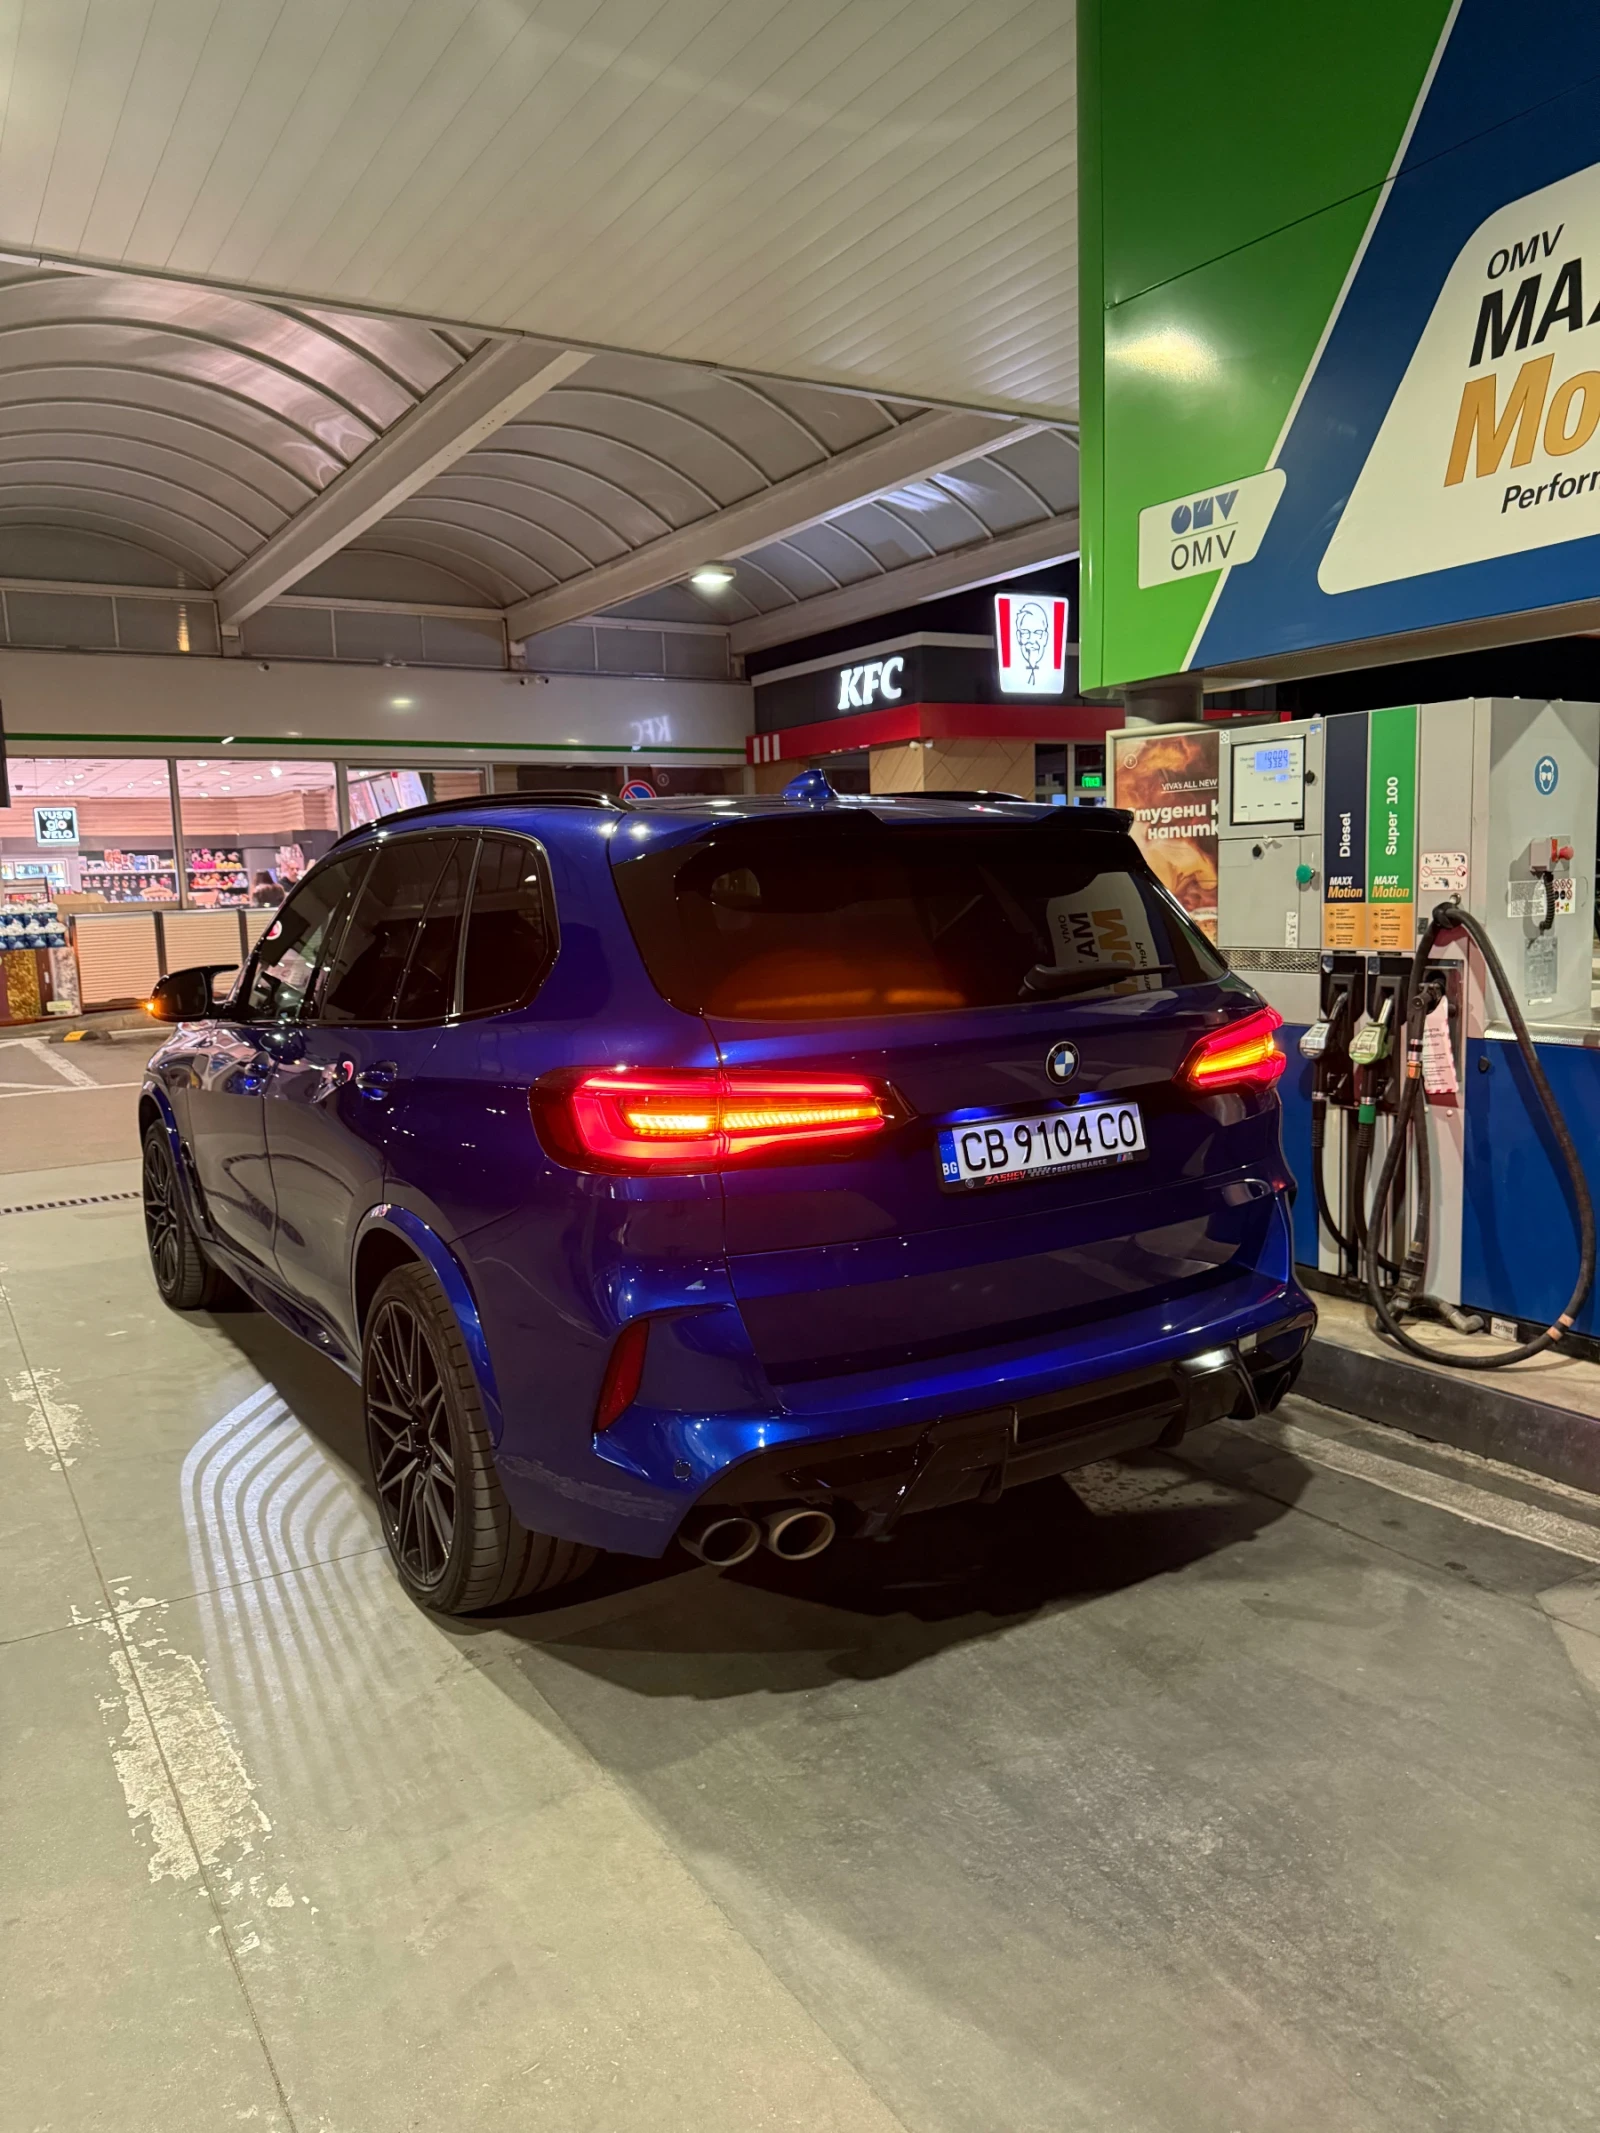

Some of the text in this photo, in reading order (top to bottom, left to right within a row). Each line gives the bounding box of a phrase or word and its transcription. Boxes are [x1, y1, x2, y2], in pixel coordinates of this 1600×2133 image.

[1487, 223, 1565, 279] OMV
[1469, 257, 1600, 368] MA
[1171, 530, 1236, 571] OMV
[838, 656, 903, 710] KFC
[1184, 780, 1198, 788] ALL
[1199, 778, 1218, 787] NEW
[1385, 776, 1400, 855] Super 100
[46, 819, 67, 831] glo
[42, 830, 73, 839] VELO
[1339, 812, 1351, 857] Diesel
[1329, 876, 1353, 886] MAXX
[1373, 875, 1399, 885] MAXX
[1327, 886, 1363, 899] Motion
[1372, 885, 1410, 898] Motion
[942, 1161, 958, 1177] BG
[1051, 1159, 1107, 1174] PERFORMANCE
